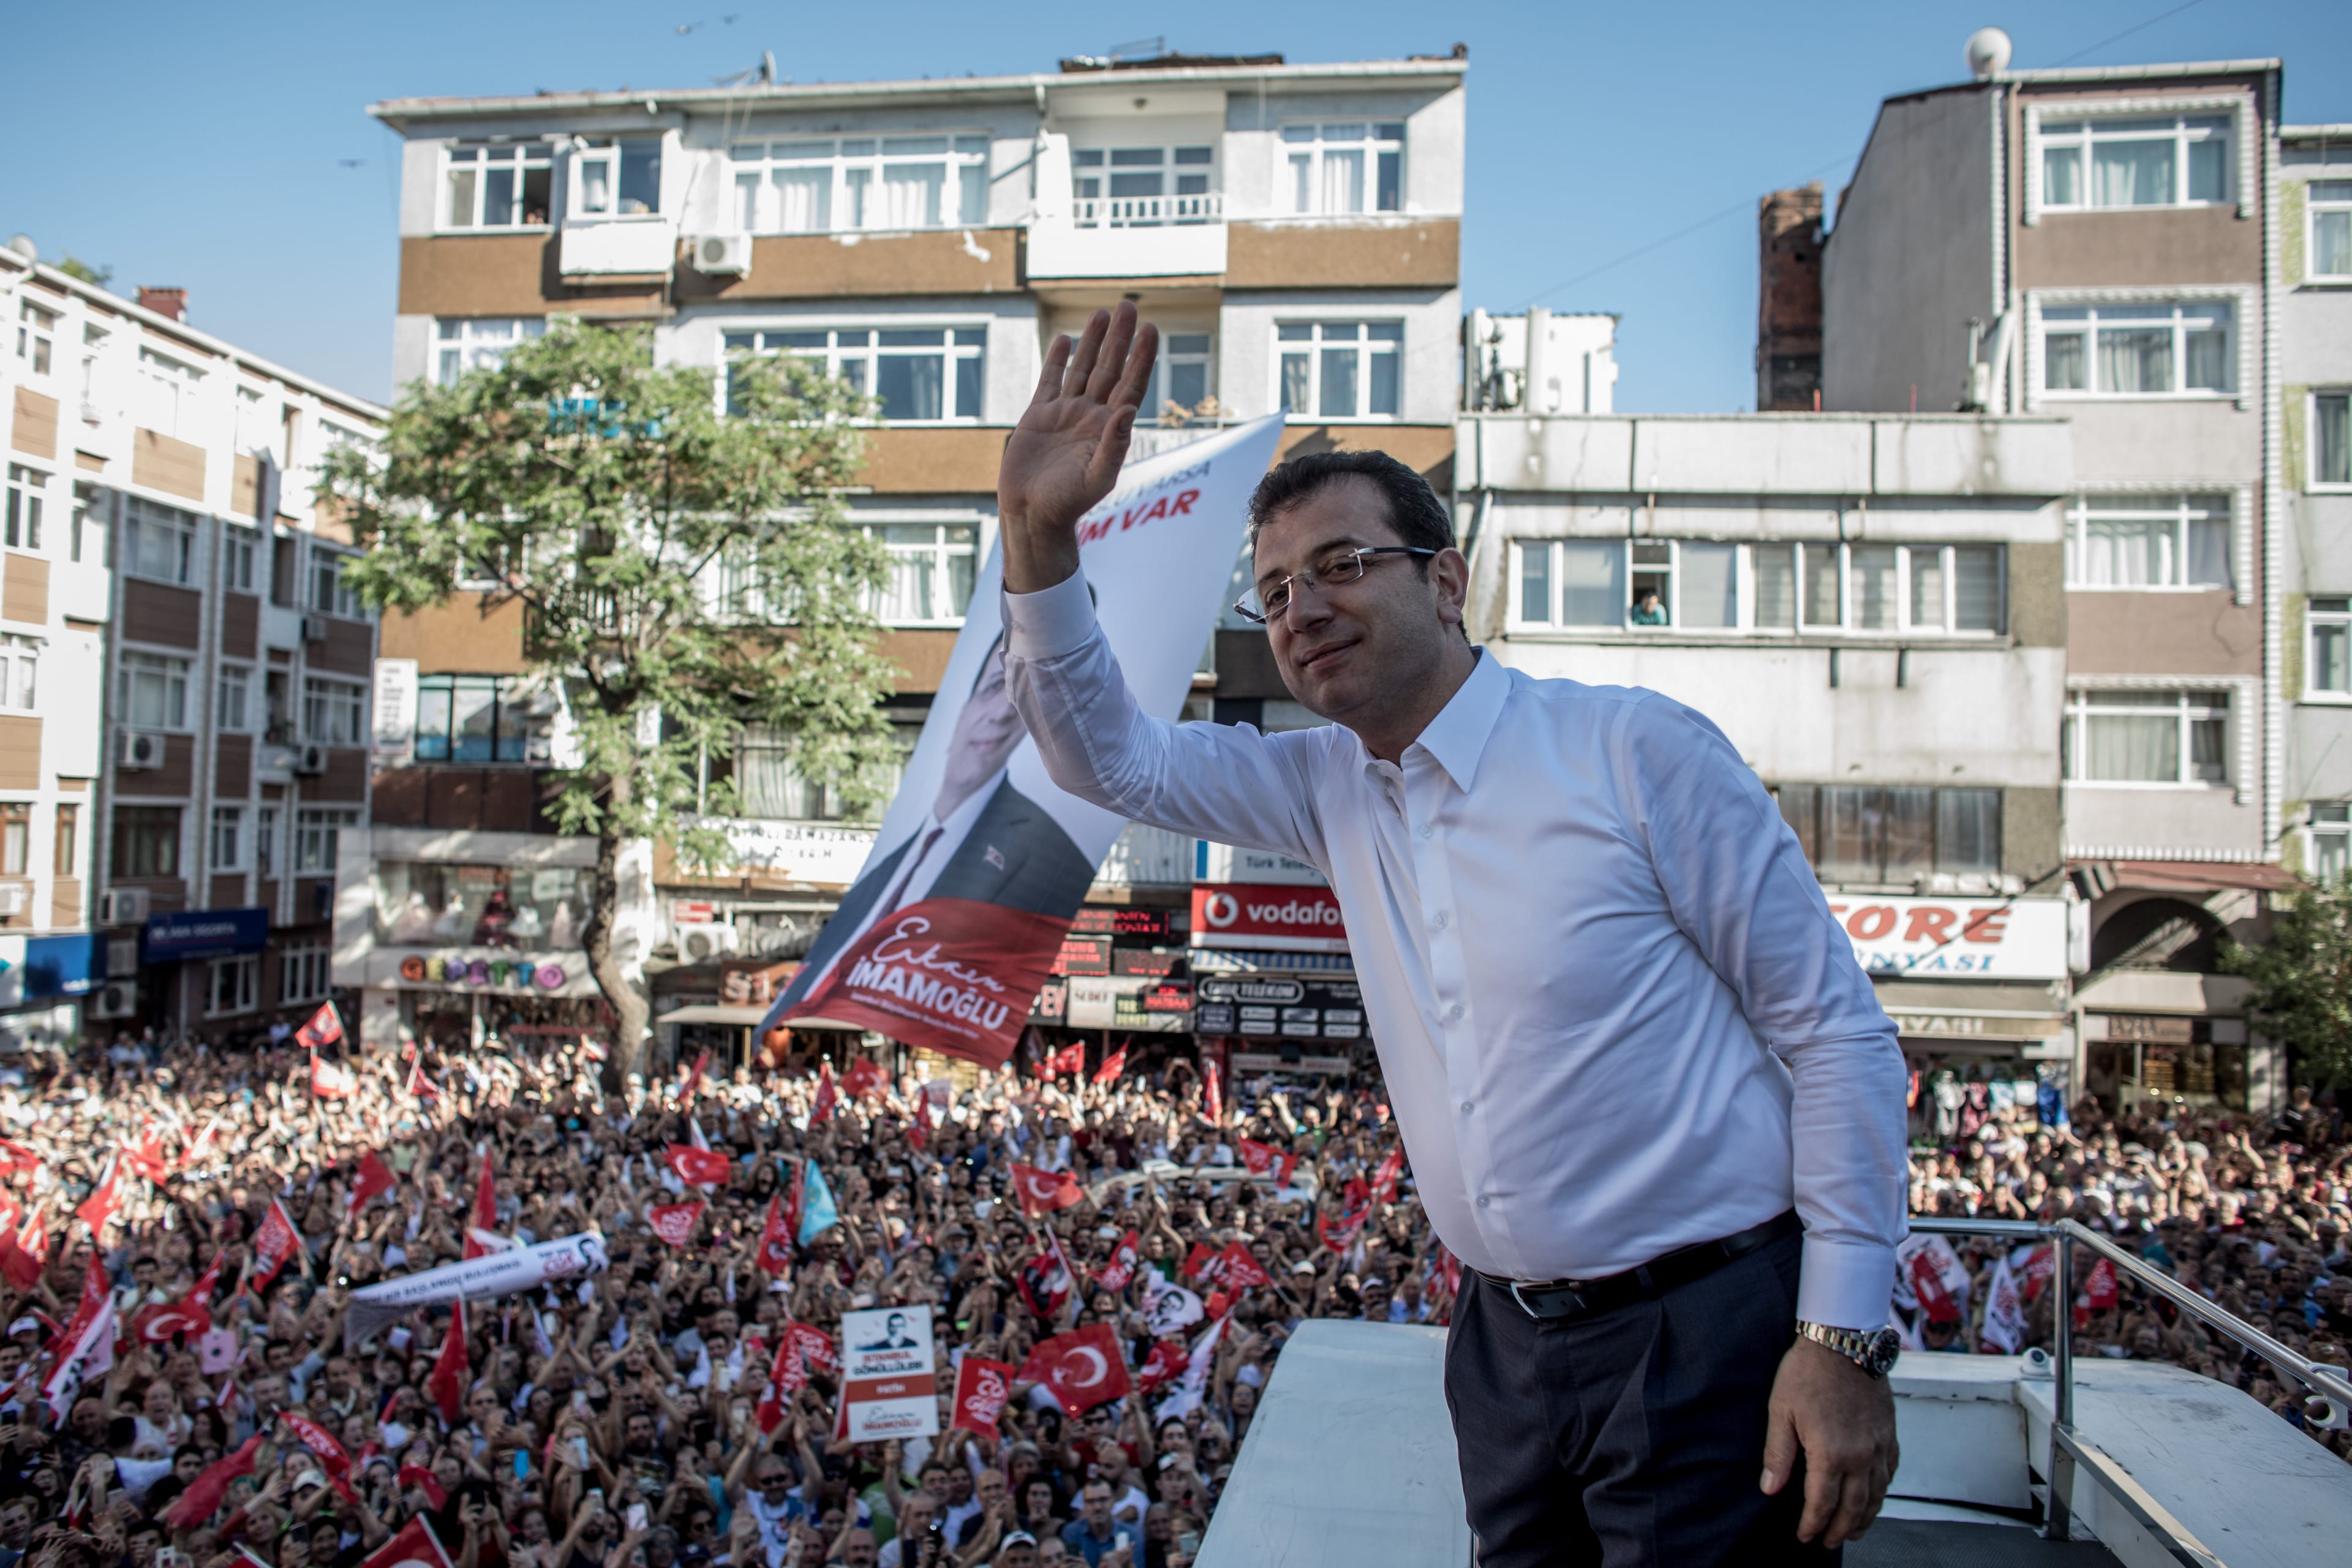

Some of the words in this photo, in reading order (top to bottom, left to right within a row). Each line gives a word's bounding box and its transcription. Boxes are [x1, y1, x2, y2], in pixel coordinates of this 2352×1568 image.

[1121, 488, 1201, 532] VAR
[1246, 856, 1275, 869] Türk
[1246, 899, 1343, 925] vodafo
[872, 916, 1005, 992] Ekrem
[845, 956, 1009, 1030] İMAMOĞLU
